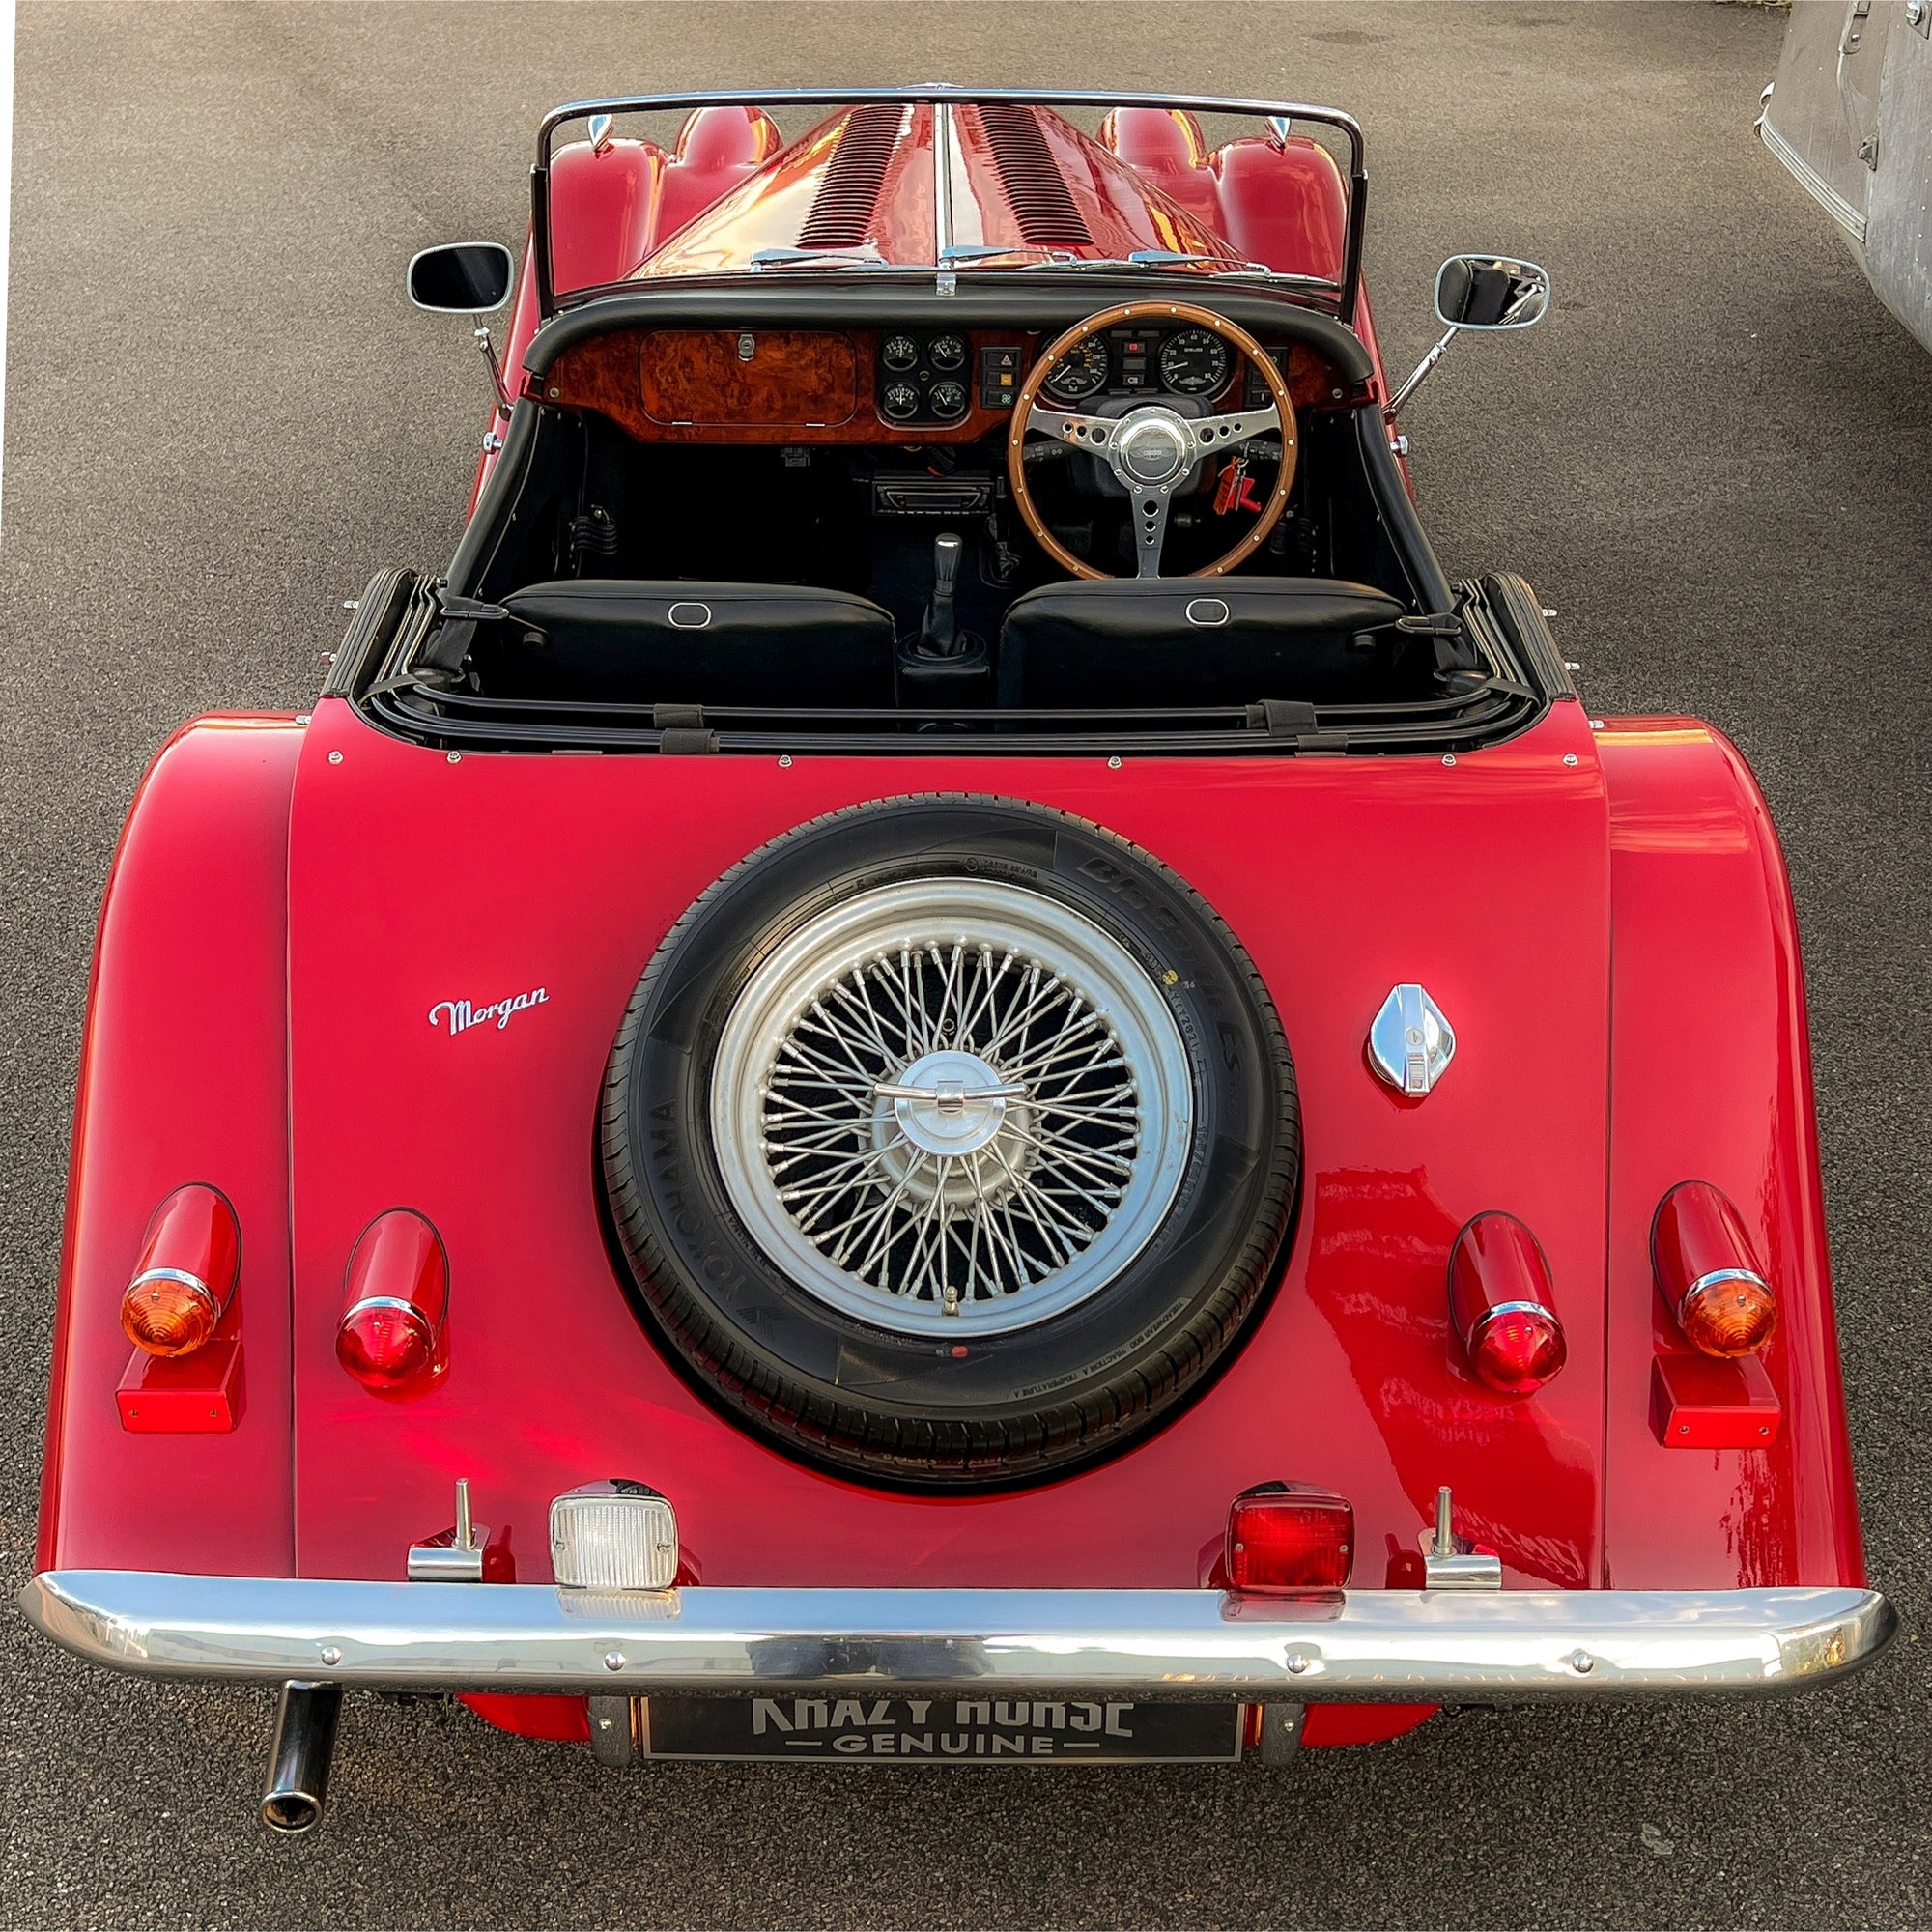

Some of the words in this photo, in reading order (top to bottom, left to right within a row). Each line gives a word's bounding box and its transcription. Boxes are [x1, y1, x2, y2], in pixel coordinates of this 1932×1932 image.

[428, 987, 550, 1036] Morgan
[648, 1097, 748, 1302] YOKOHAMA
[1089, 1347, 1127, 1375] TRACTION
[1022, 1373, 1080, 1397] TEMPERATURE
[833, 1732, 1054, 1754] GENUINE
